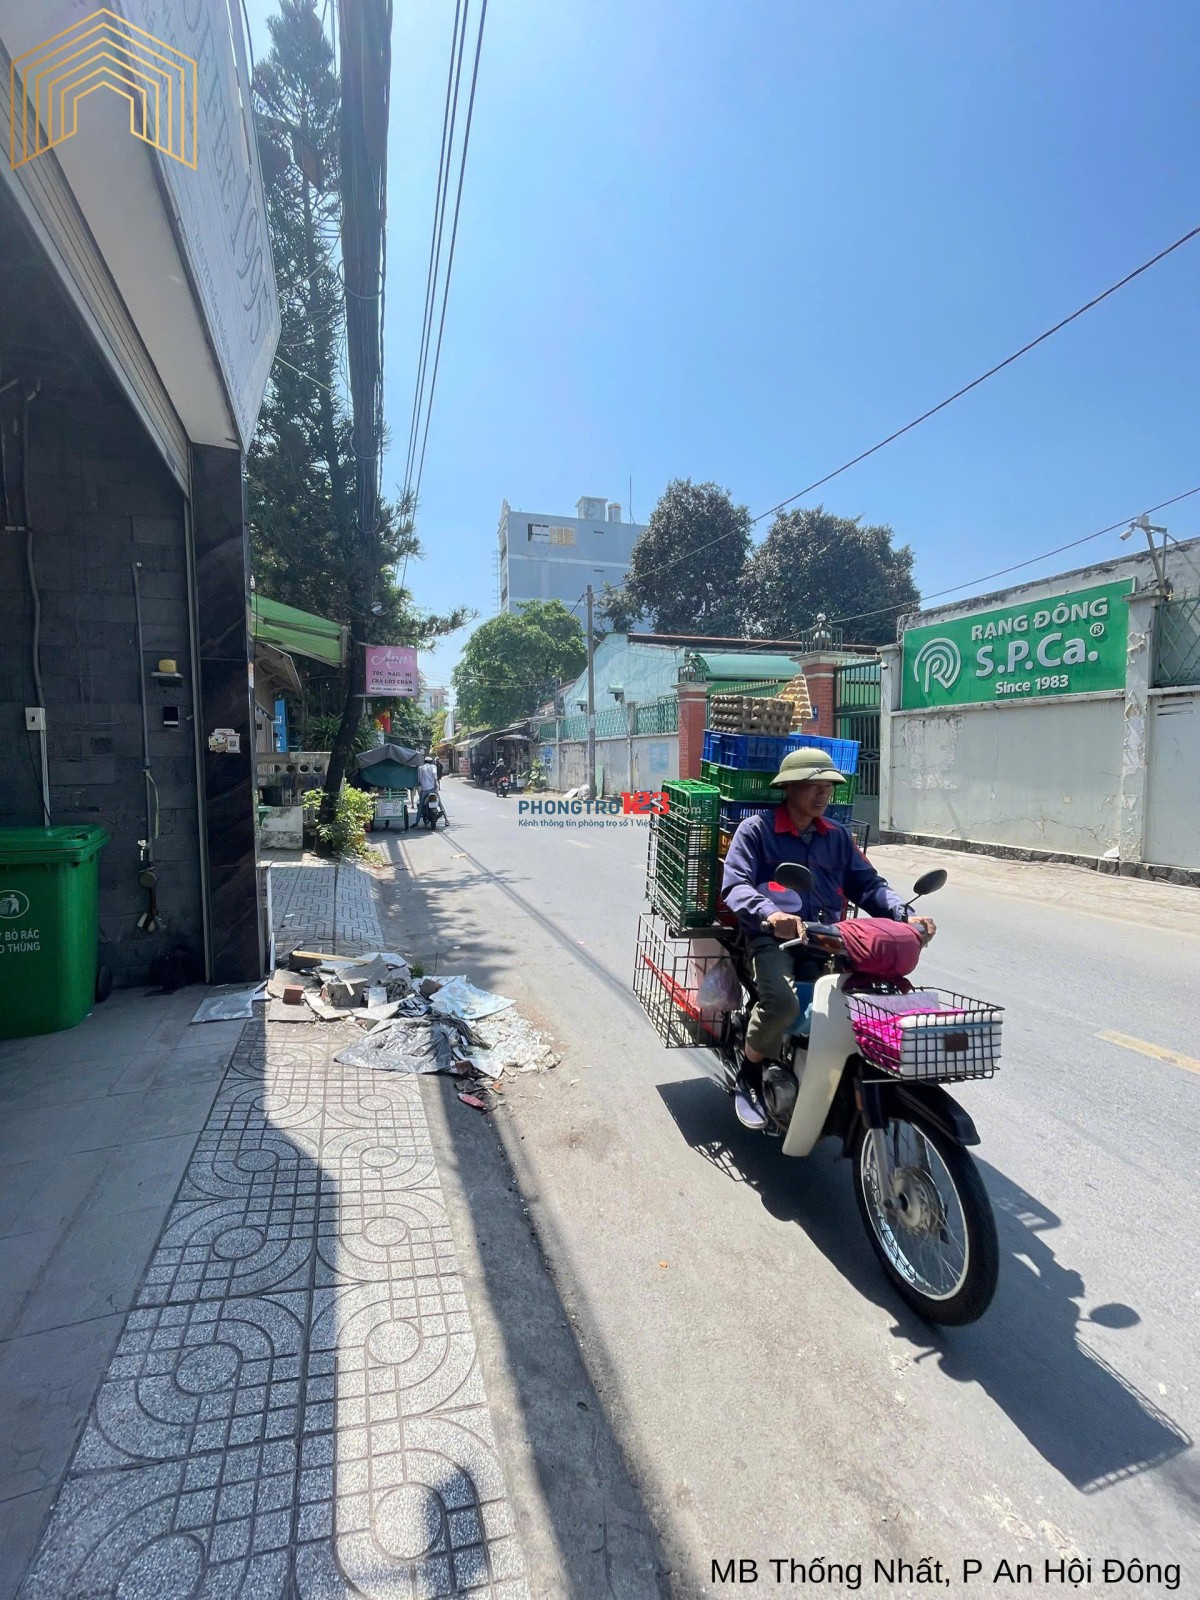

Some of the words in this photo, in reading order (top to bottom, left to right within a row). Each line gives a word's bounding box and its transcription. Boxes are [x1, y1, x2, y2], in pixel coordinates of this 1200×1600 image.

[230, 172, 272, 344] 1995
[971, 615, 1029, 641] RẠNG
[1033, 597, 1108, 630] ĐÔNG
[976, 633, 1099, 678] S.P.Ca.
[995, 680, 1031, 695] Since
[1034, 674, 1069, 691] 1983
[8, 941, 40, 953] THÙNG
[21, 927, 40, 940] RÁC
